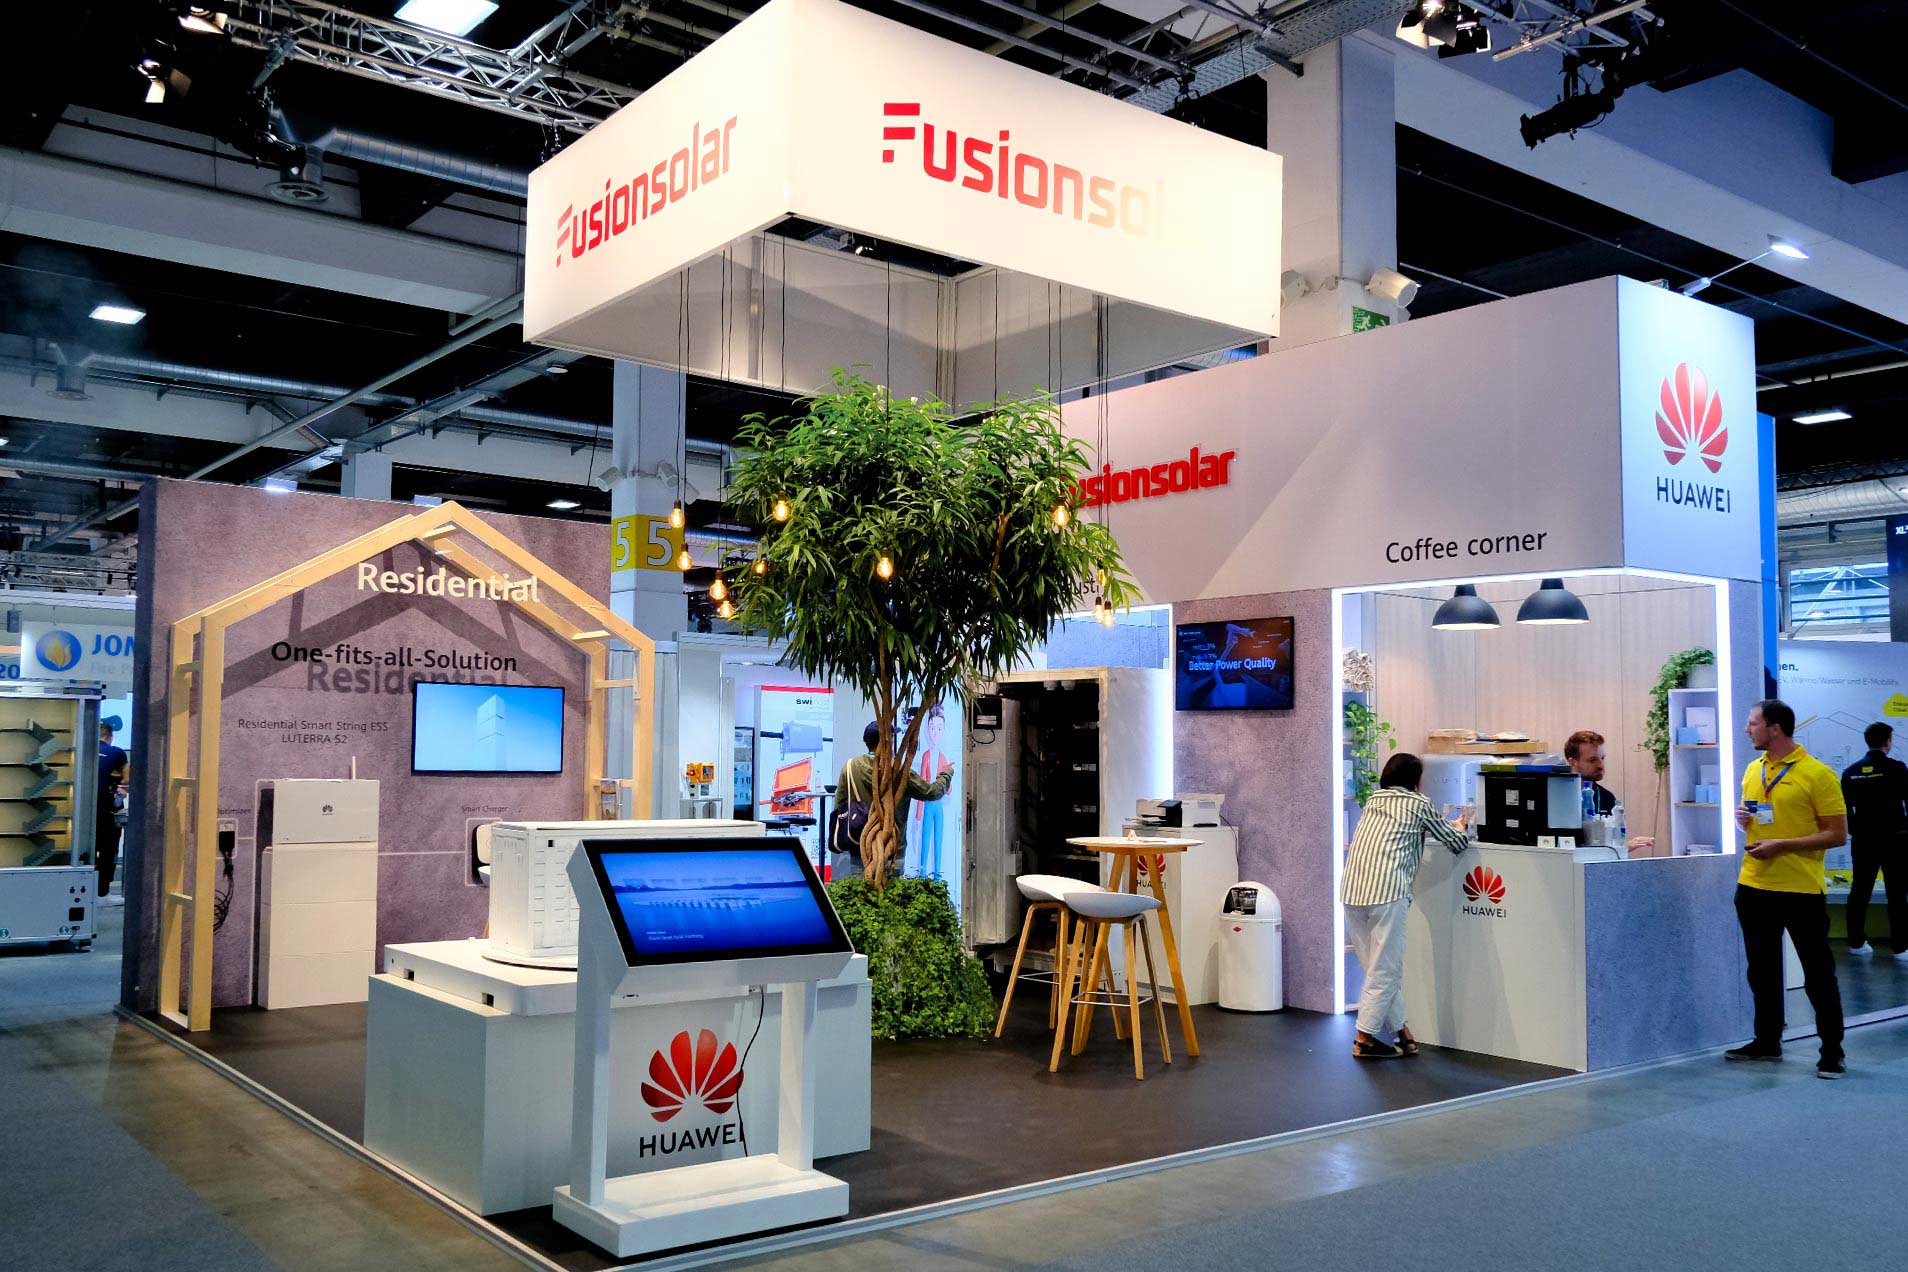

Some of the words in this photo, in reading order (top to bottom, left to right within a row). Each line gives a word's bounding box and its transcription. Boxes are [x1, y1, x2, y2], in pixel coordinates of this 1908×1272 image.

[882, 103, 1168, 241] Fusionsol
[556, 114, 738, 268] Fusionsolar
[1062, 447, 1236, 509] usionsolar
[1656, 475, 1731, 514] HUAWEI
[616, 520, 630, 568] 5
[647, 520, 673, 567] 5
[1386, 537, 1458, 564] Coffee
[1467, 531, 1548, 556] corner
[357, 562, 541, 603] Residential
[271, 640, 518, 672] One-fits-all-Solution
[1188, 659, 1214, 671] Better
[1215, 659, 1243, 670] Power
[1243, 657, 1277, 671] Quality
[238, 718, 297, 731] Residential
[301, 720, 332, 731] Smart
[336, 721, 367, 734] String
[370, 722, 388, 732] ESS
[282, 734, 331, 744] LUTERRA
[335, 734, 347, 744] S2
[461, 805, 480, 814] Smart
[482, 805, 509, 815] Charger
[1462, 905, 1507, 918] HUAWEI
[639, 1122, 744, 1158] HUAWEI
